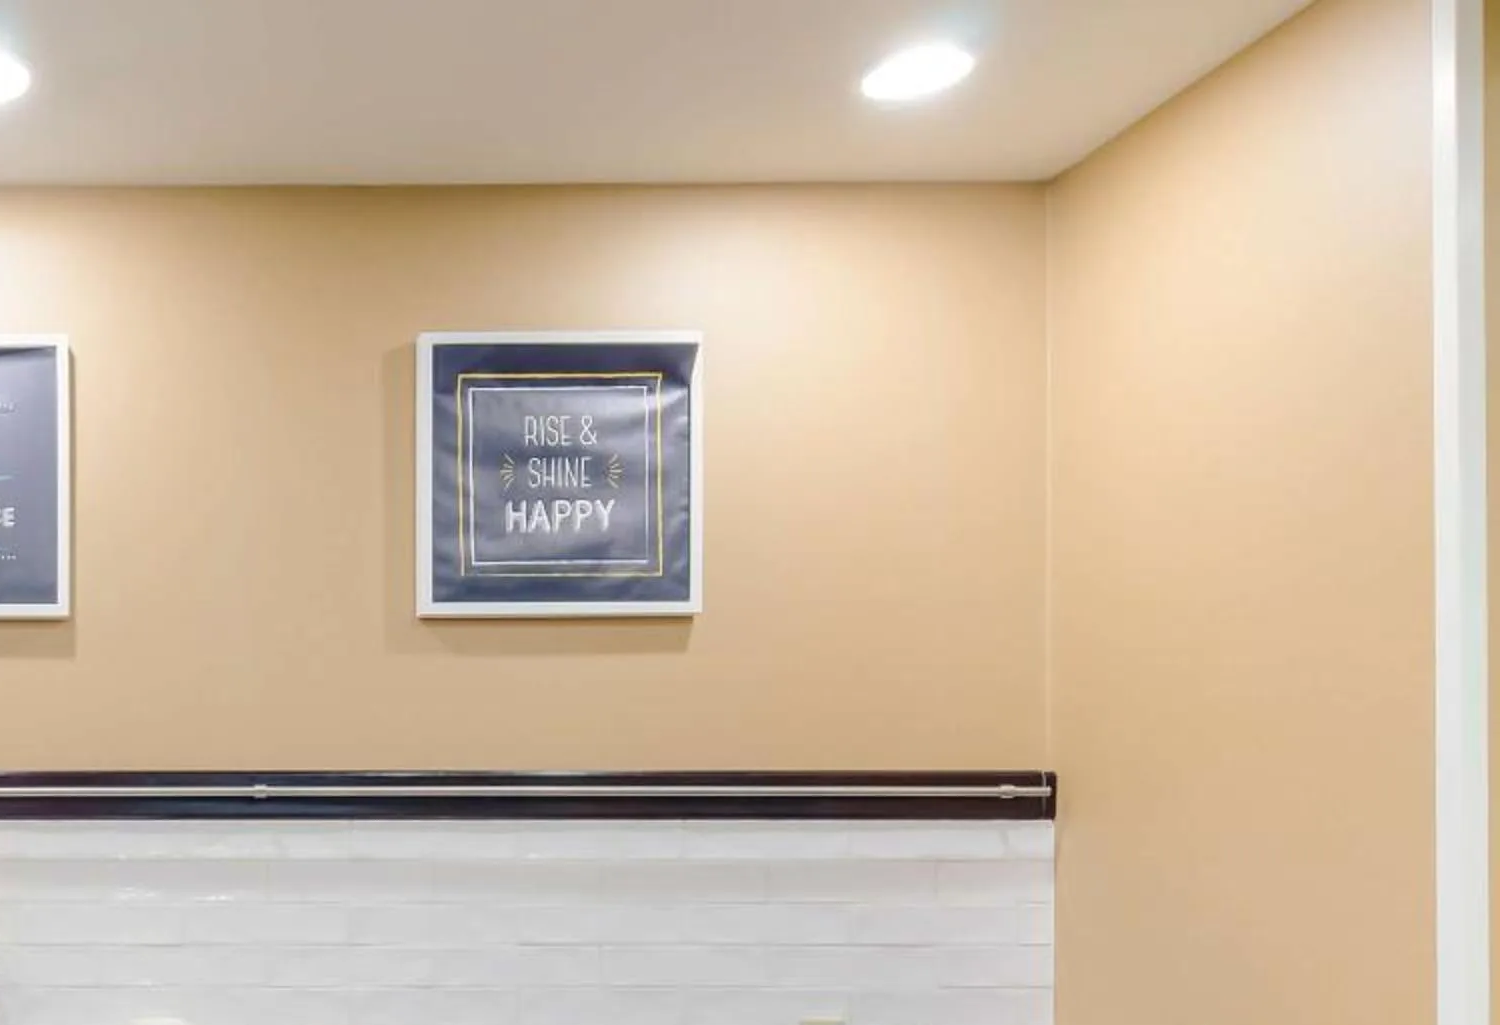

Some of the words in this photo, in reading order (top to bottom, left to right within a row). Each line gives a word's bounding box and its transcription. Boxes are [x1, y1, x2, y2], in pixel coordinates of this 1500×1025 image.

[524, 415, 572, 447] RISE
[579, 414, 598, 446] &
[527, 456, 593, 488] SHINE
[505, 499, 616, 533] HAPPY
